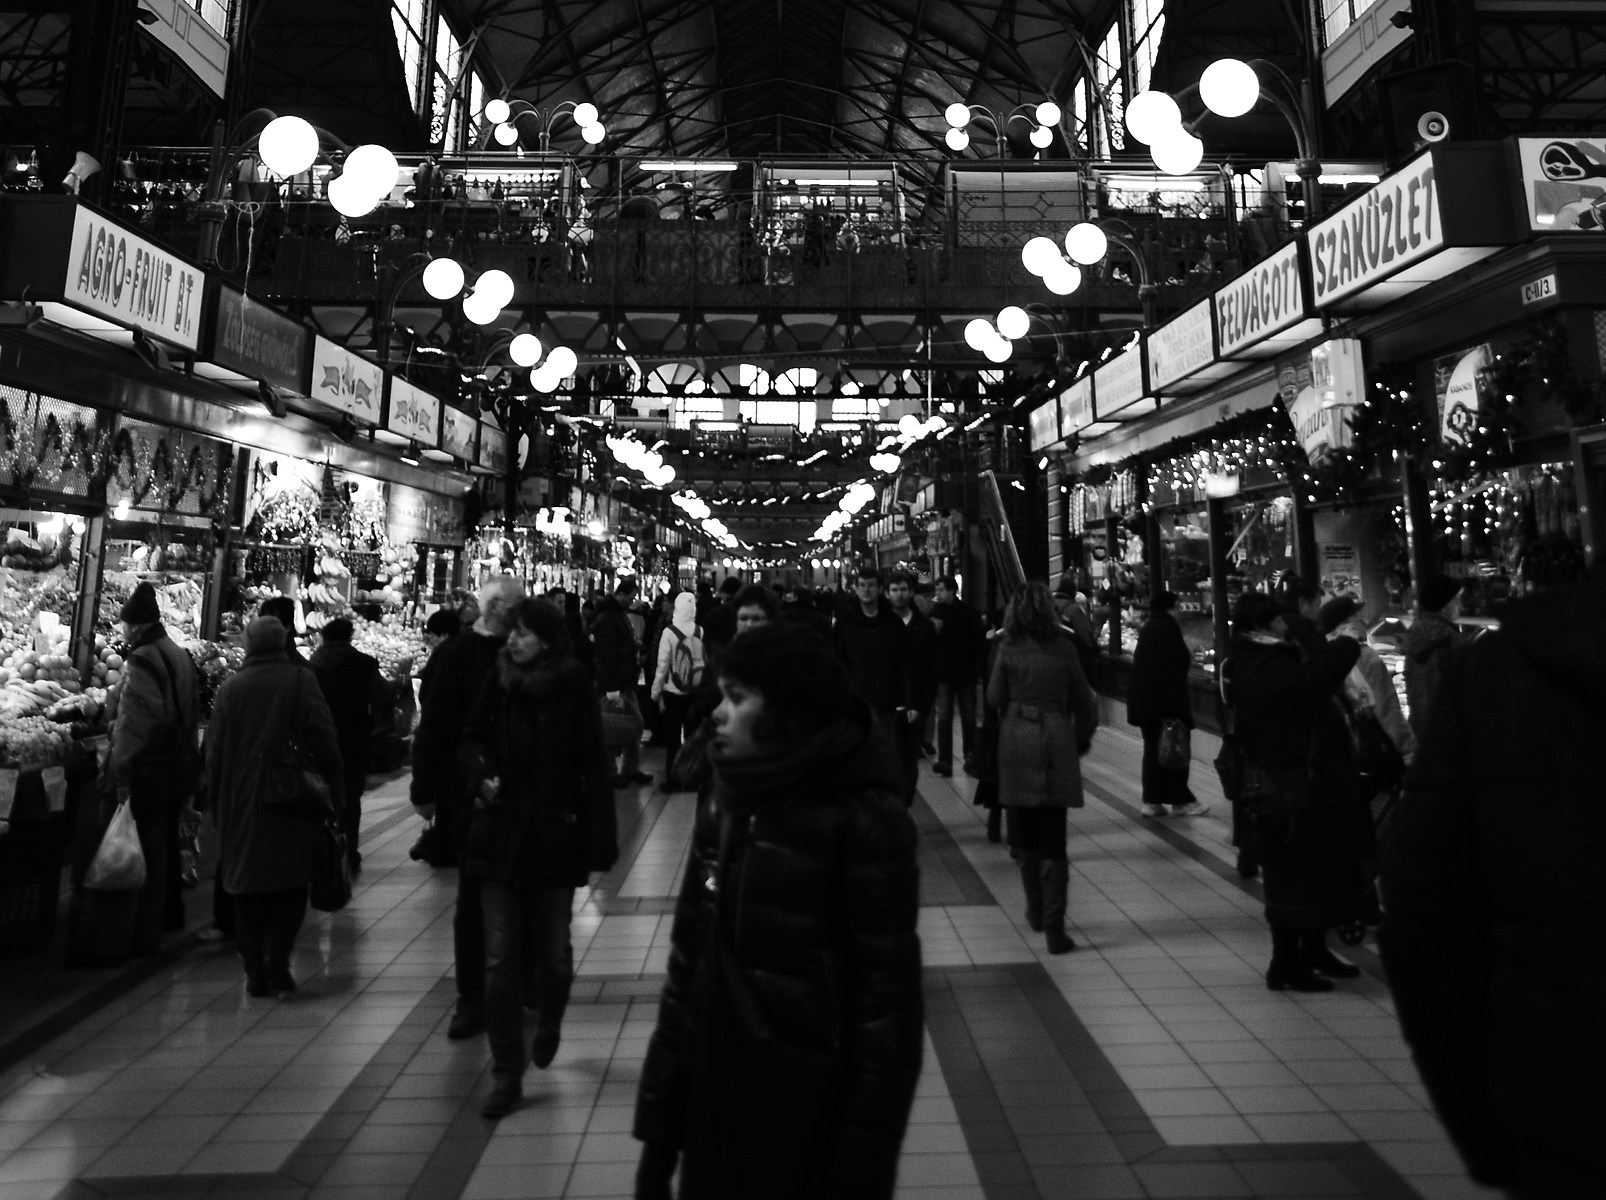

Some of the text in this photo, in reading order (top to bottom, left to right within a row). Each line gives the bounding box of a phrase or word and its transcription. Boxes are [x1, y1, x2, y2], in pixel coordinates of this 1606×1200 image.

[77, 222, 172, 325] AGRO-FRUIT
[1315, 166, 1434, 297] SZAKÜZLET
[1218, 253, 1299, 348] FELVÁGOTT
